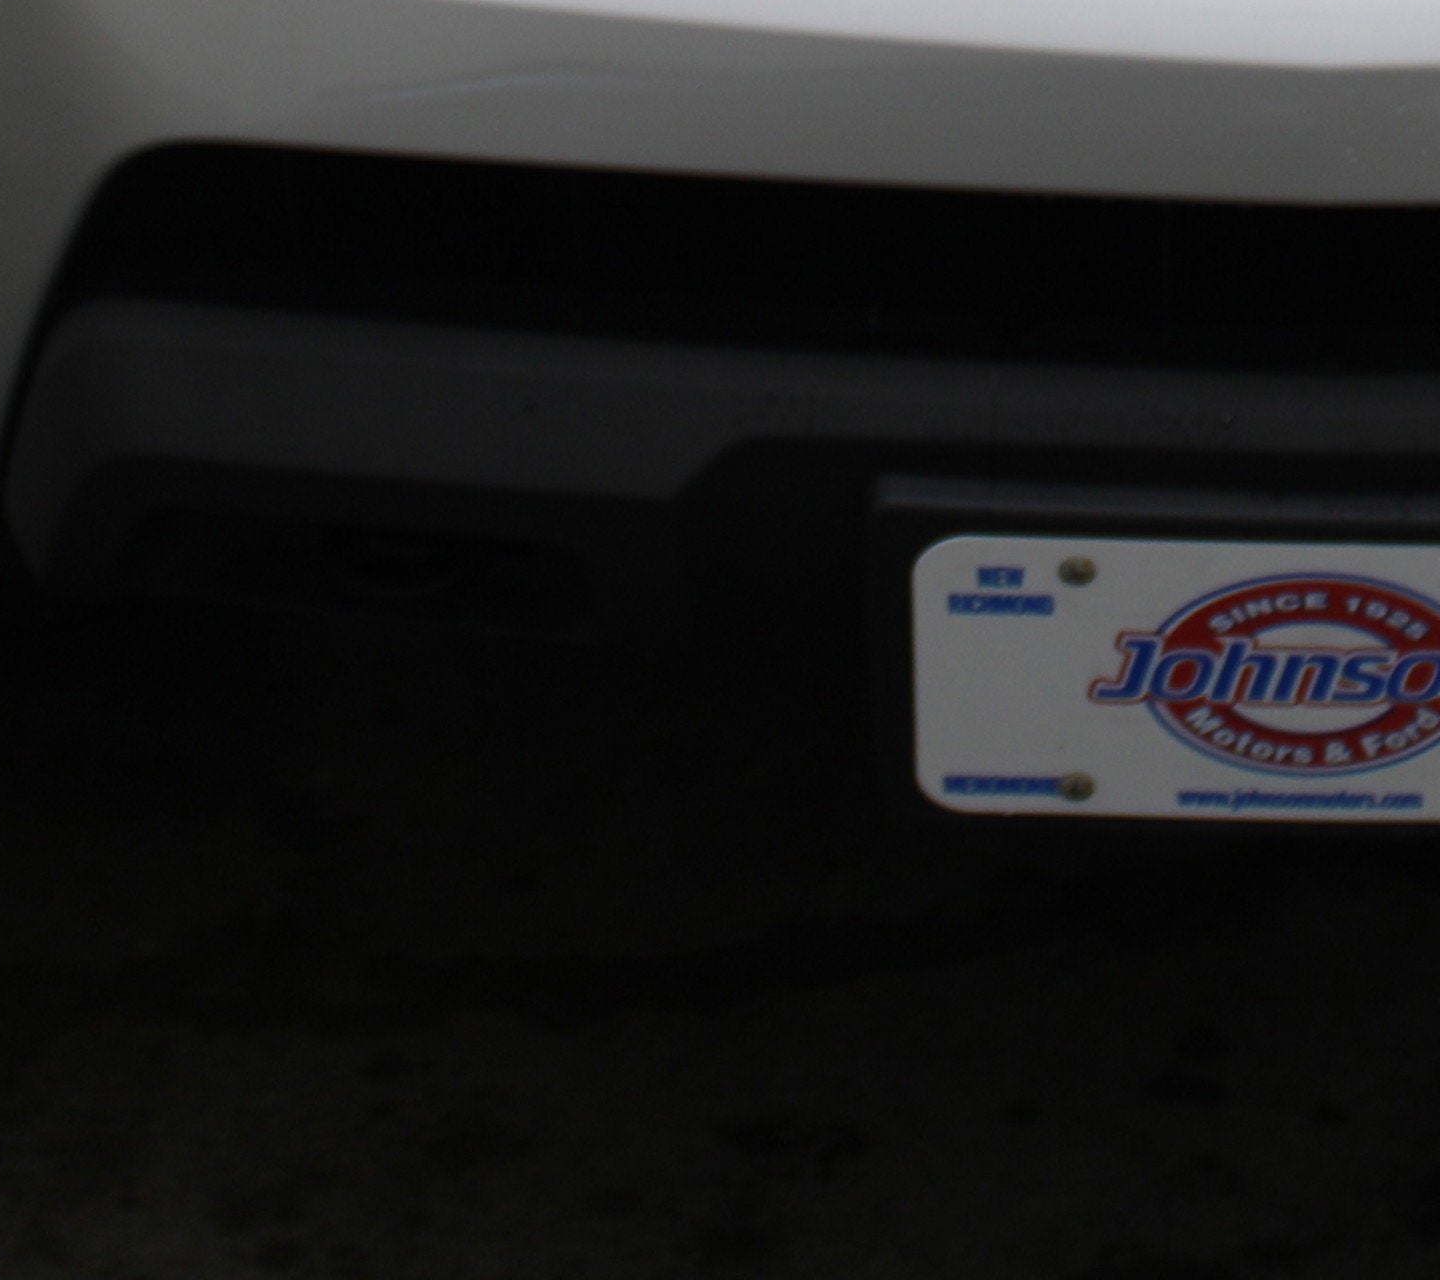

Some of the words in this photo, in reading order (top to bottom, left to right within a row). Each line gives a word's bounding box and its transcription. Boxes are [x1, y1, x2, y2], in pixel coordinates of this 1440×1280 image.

[976, 566, 1025, 588] NEW
[948, 593, 1055, 616] RICHMOND
[1208, 591, 1329, 634] SINCE
[1184, 706, 1313, 765] Motors
[1322, 742, 1352, 763] &
